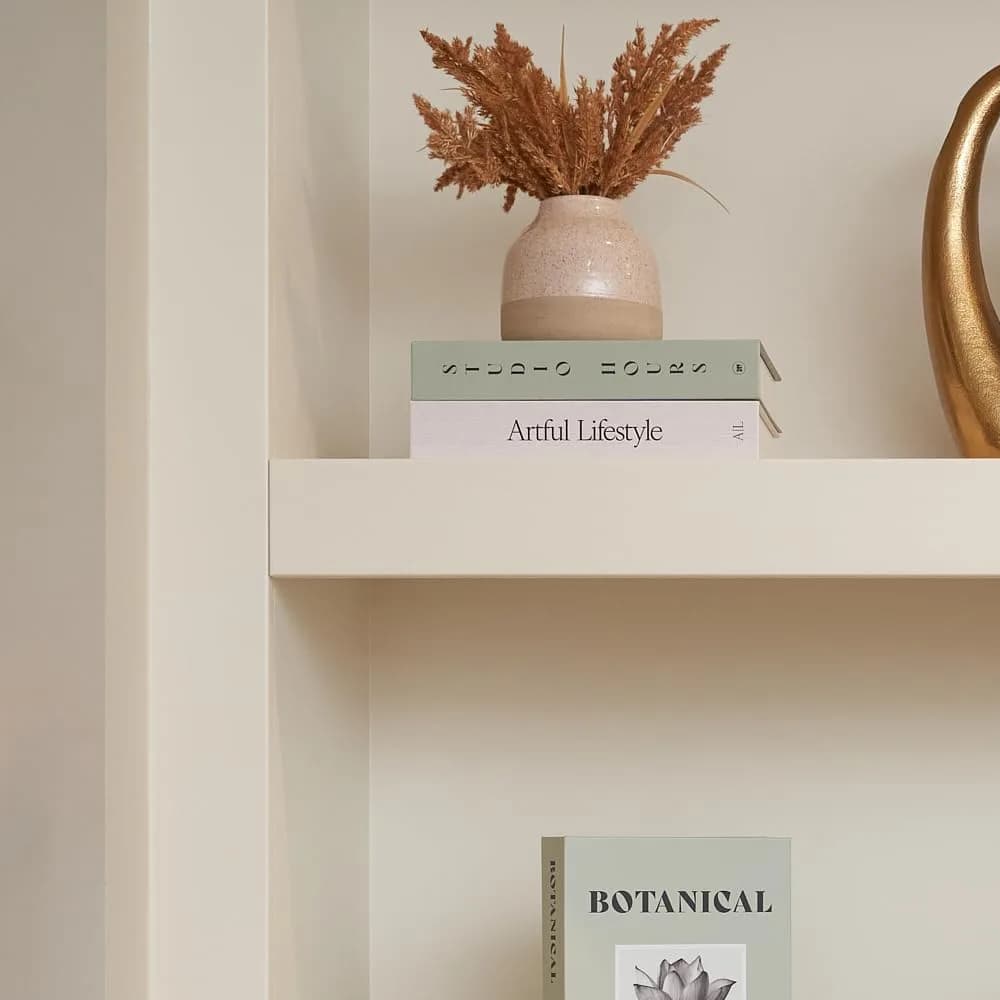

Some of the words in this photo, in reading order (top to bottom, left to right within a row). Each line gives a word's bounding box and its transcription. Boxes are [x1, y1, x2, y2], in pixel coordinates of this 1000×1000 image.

[442, 362, 571, 376] STUDIO
[601, 361, 708, 376] HOURS
[507, 419, 570, 441] Artful
[577, 419, 663, 448] Lifestyle
[588, 889, 773, 914] BOTANICAL
[549, 861, 557, 984] BOTANICAL
